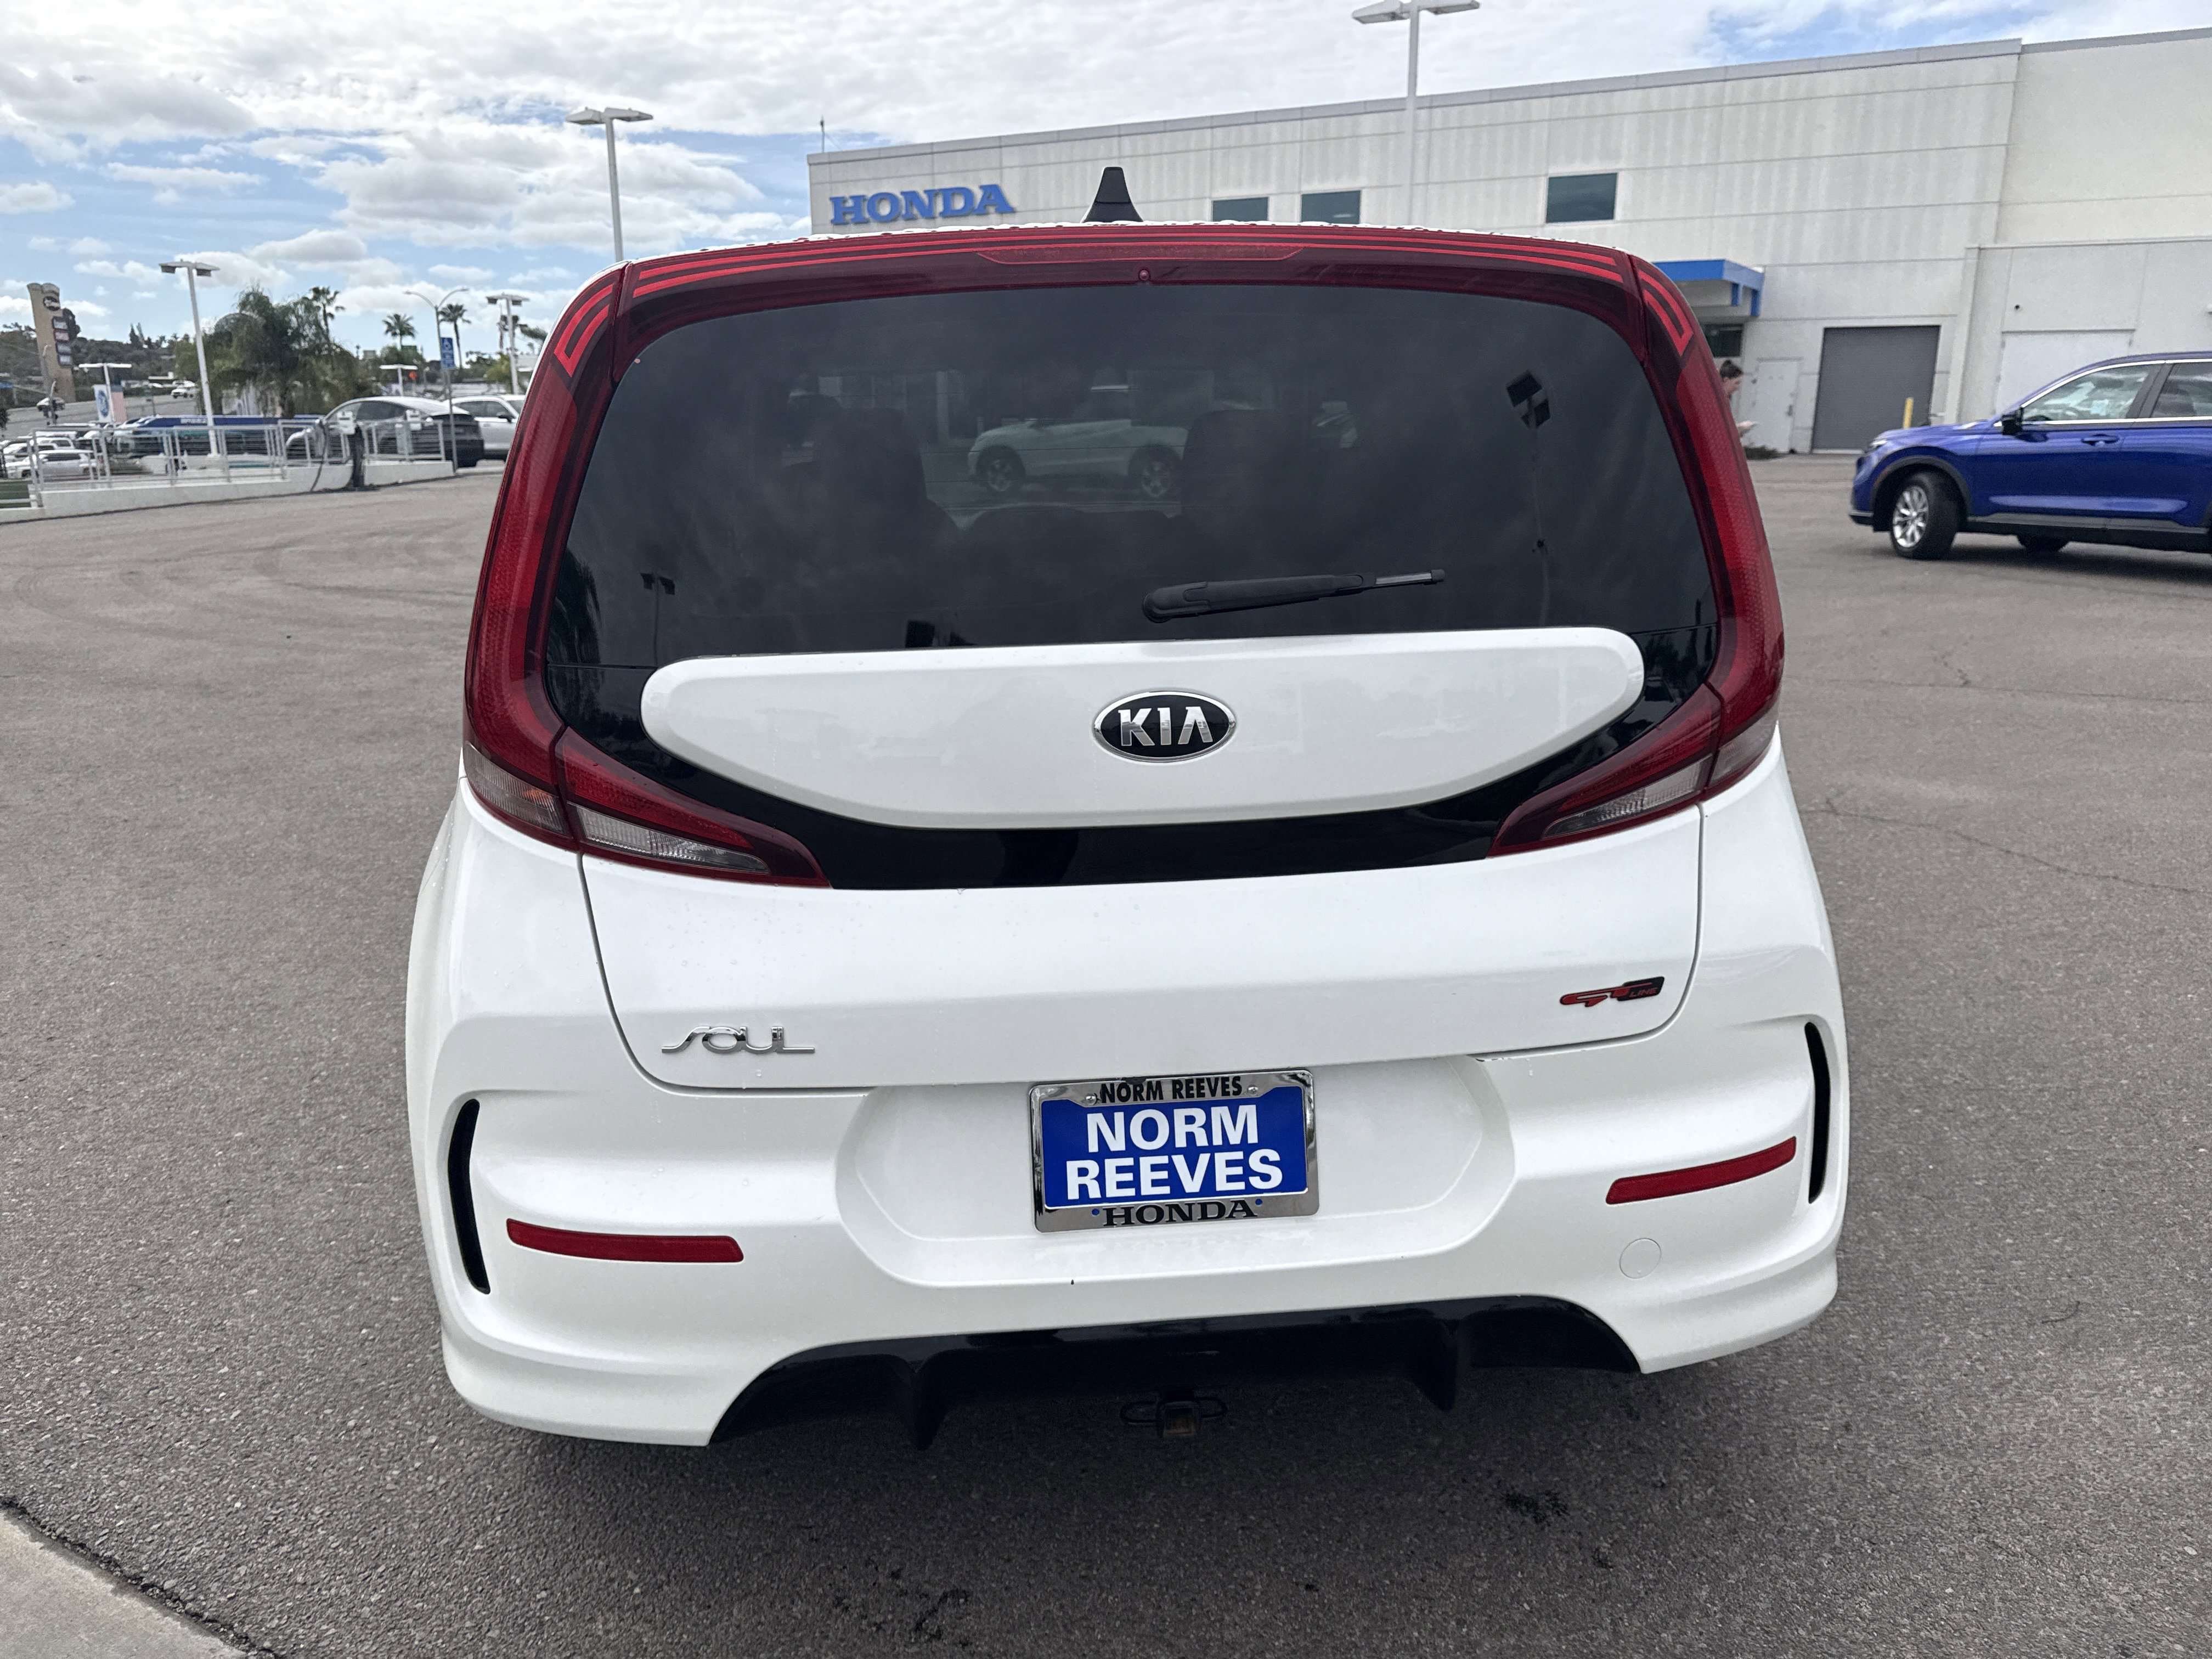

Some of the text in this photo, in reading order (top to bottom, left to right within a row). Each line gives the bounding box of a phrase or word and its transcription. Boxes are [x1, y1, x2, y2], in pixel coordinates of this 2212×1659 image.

[830, 184, 1015, 225] HONDA
[1118, 706, 1213, 746] KIA
[1629, 988, 1658, 997] LINE
[662, 1026, 815, 1054] SOUL
[1100, 1076, 1242, 1104] NORM REEVES
[1087, 1104, 1259, 1153] NORM
[1066, 1149, 1283, 1200] REEVES
[1103, 1200, 1257, 1226] HONDA
